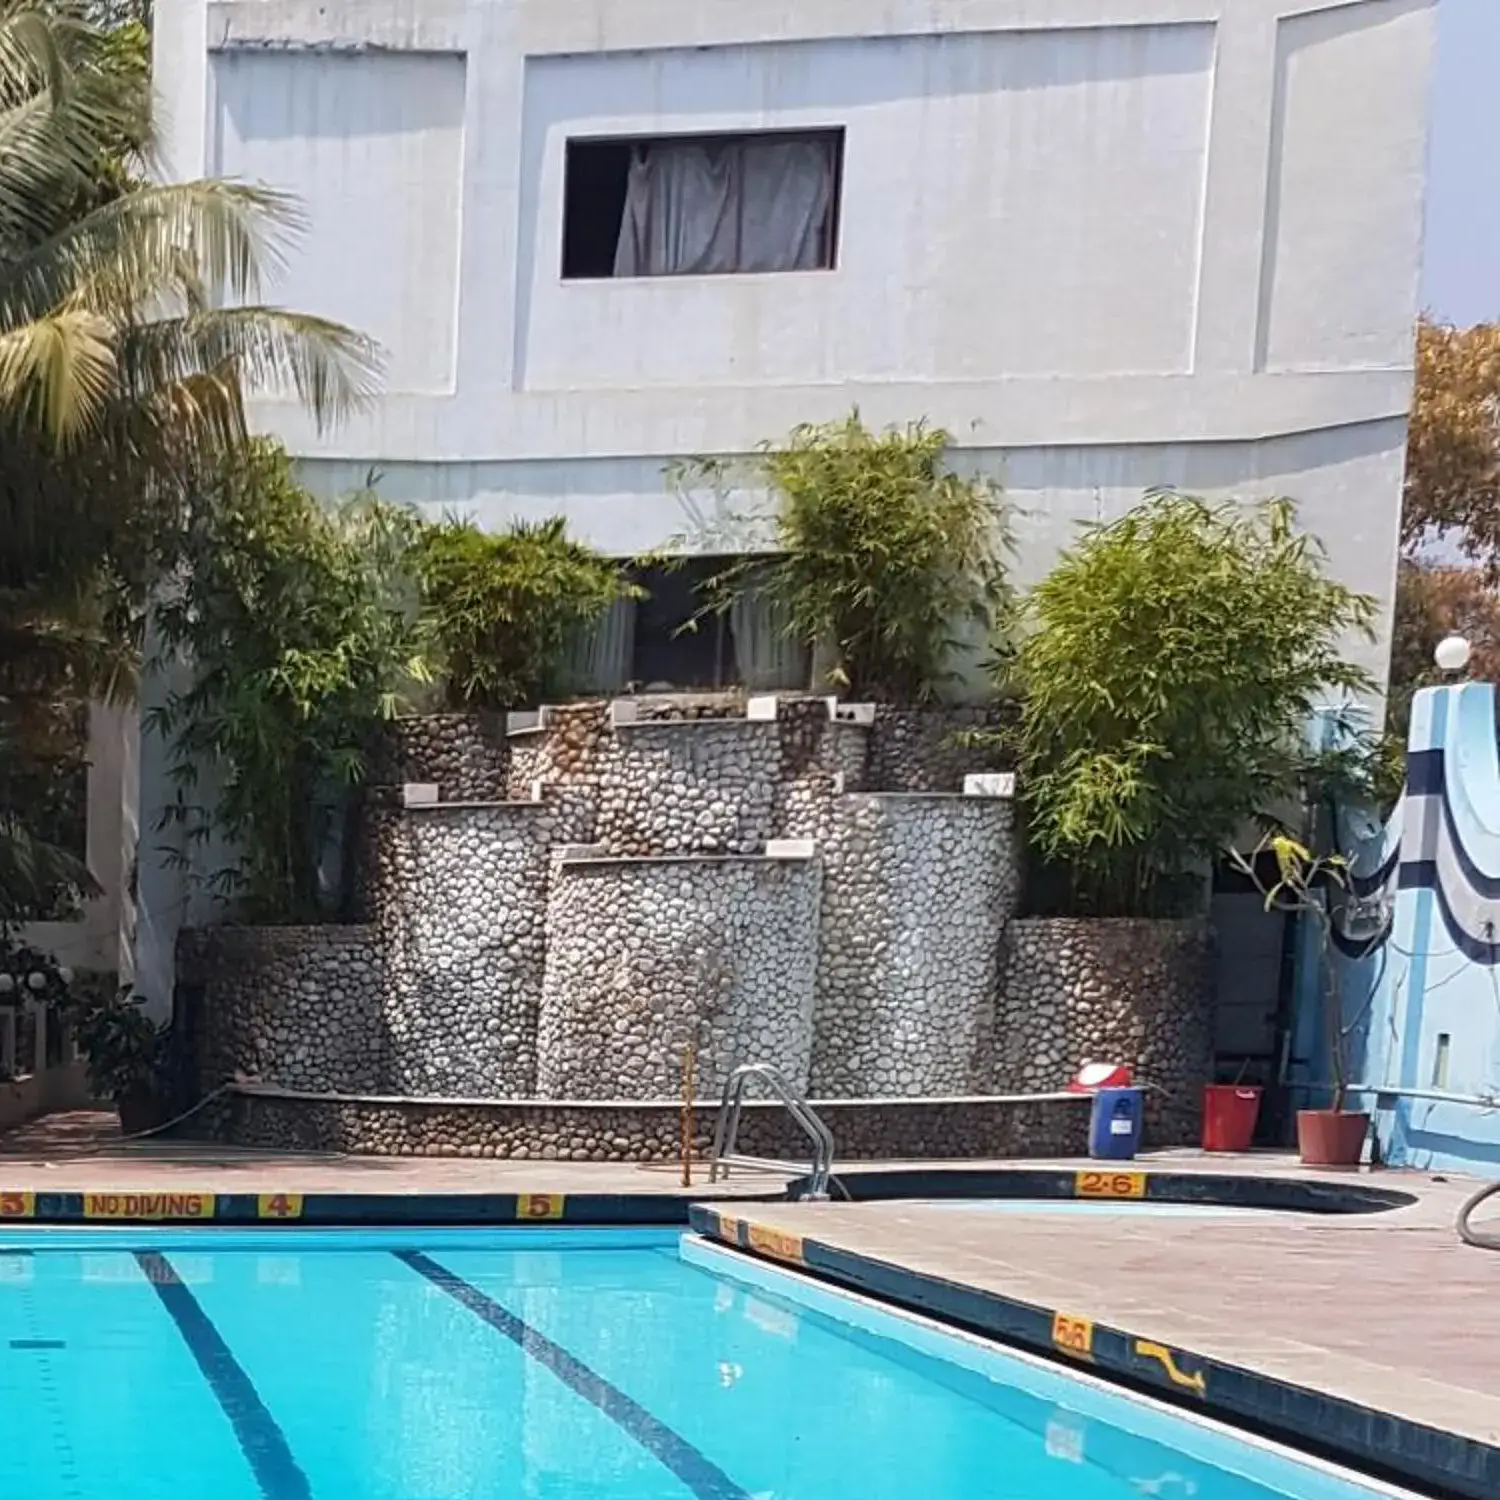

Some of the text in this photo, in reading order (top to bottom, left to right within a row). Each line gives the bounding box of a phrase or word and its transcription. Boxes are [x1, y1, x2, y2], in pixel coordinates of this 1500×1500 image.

[0, 1192, 25, 1215] 3
[90, 1194, 202, 1216] NO DIVING
[268, 1194, 293, 1217] 4
[529, 1194, 551, 1217] 5
